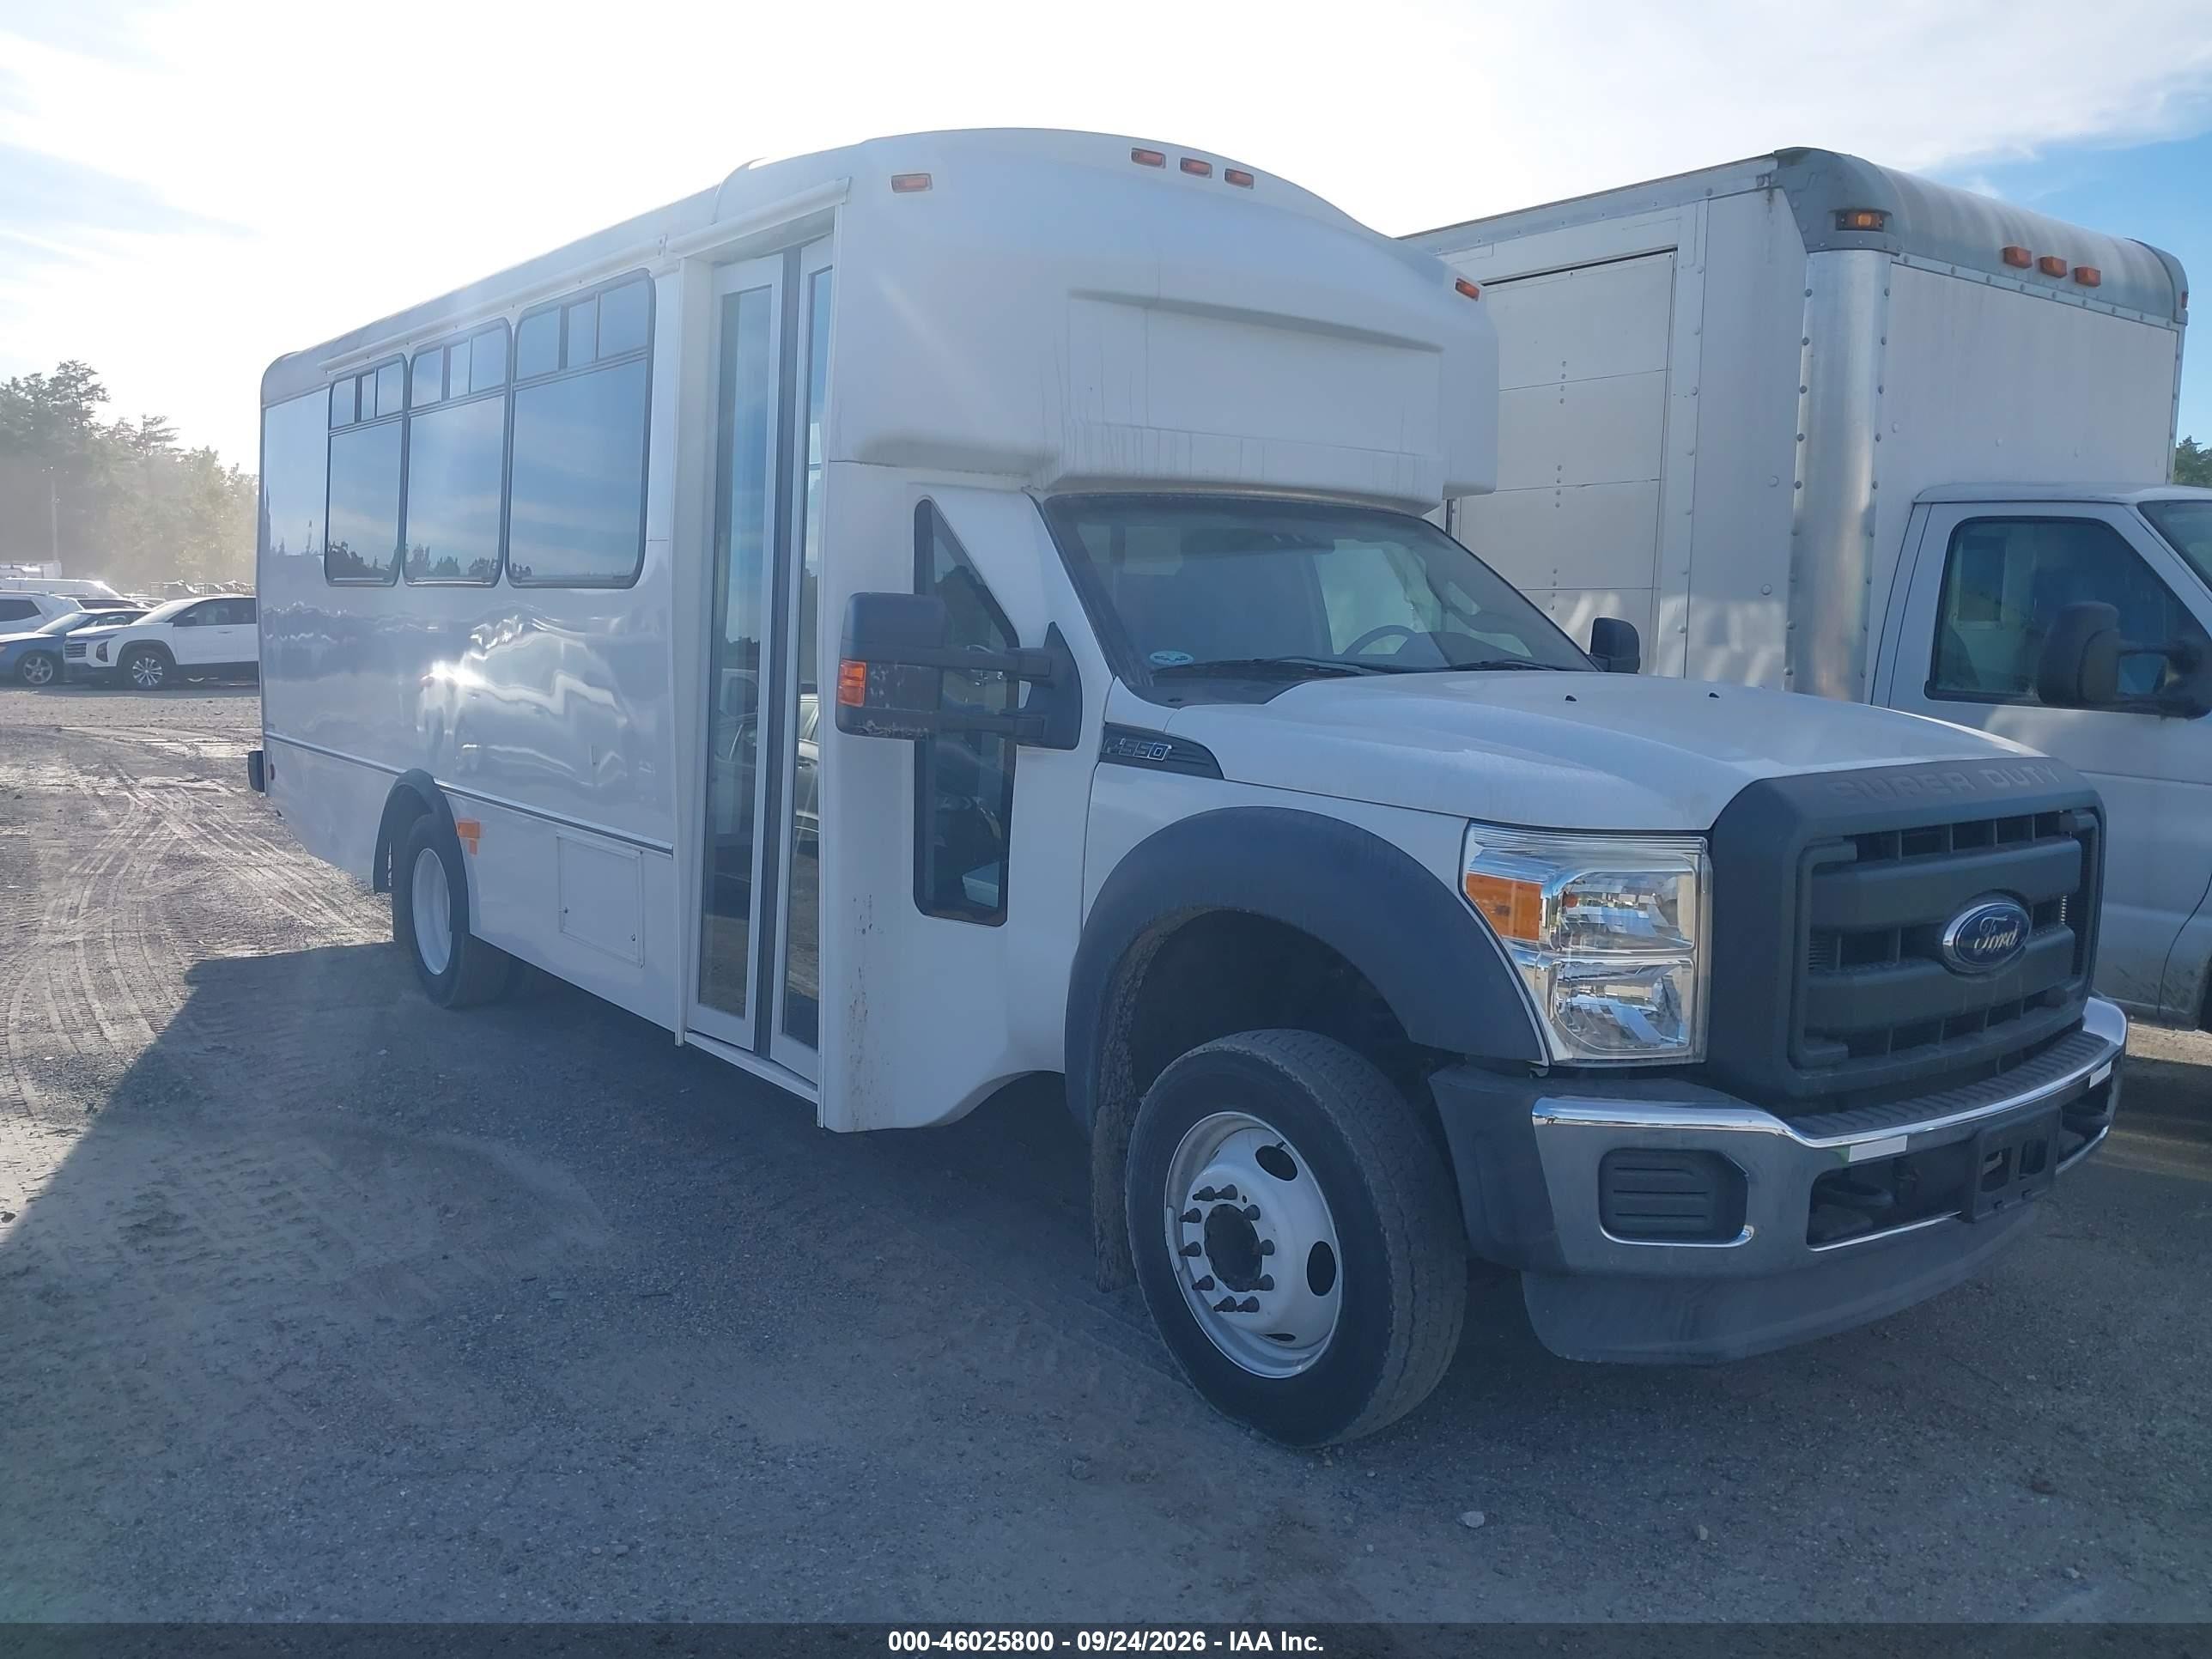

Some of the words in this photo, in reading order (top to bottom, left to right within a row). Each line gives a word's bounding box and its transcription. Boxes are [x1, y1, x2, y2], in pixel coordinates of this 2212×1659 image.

[1828, 775, 1976, 800] SUPER
[1978, 765, 2061, 787] DUTY
[1974, 915, 2020, 954] Ford
